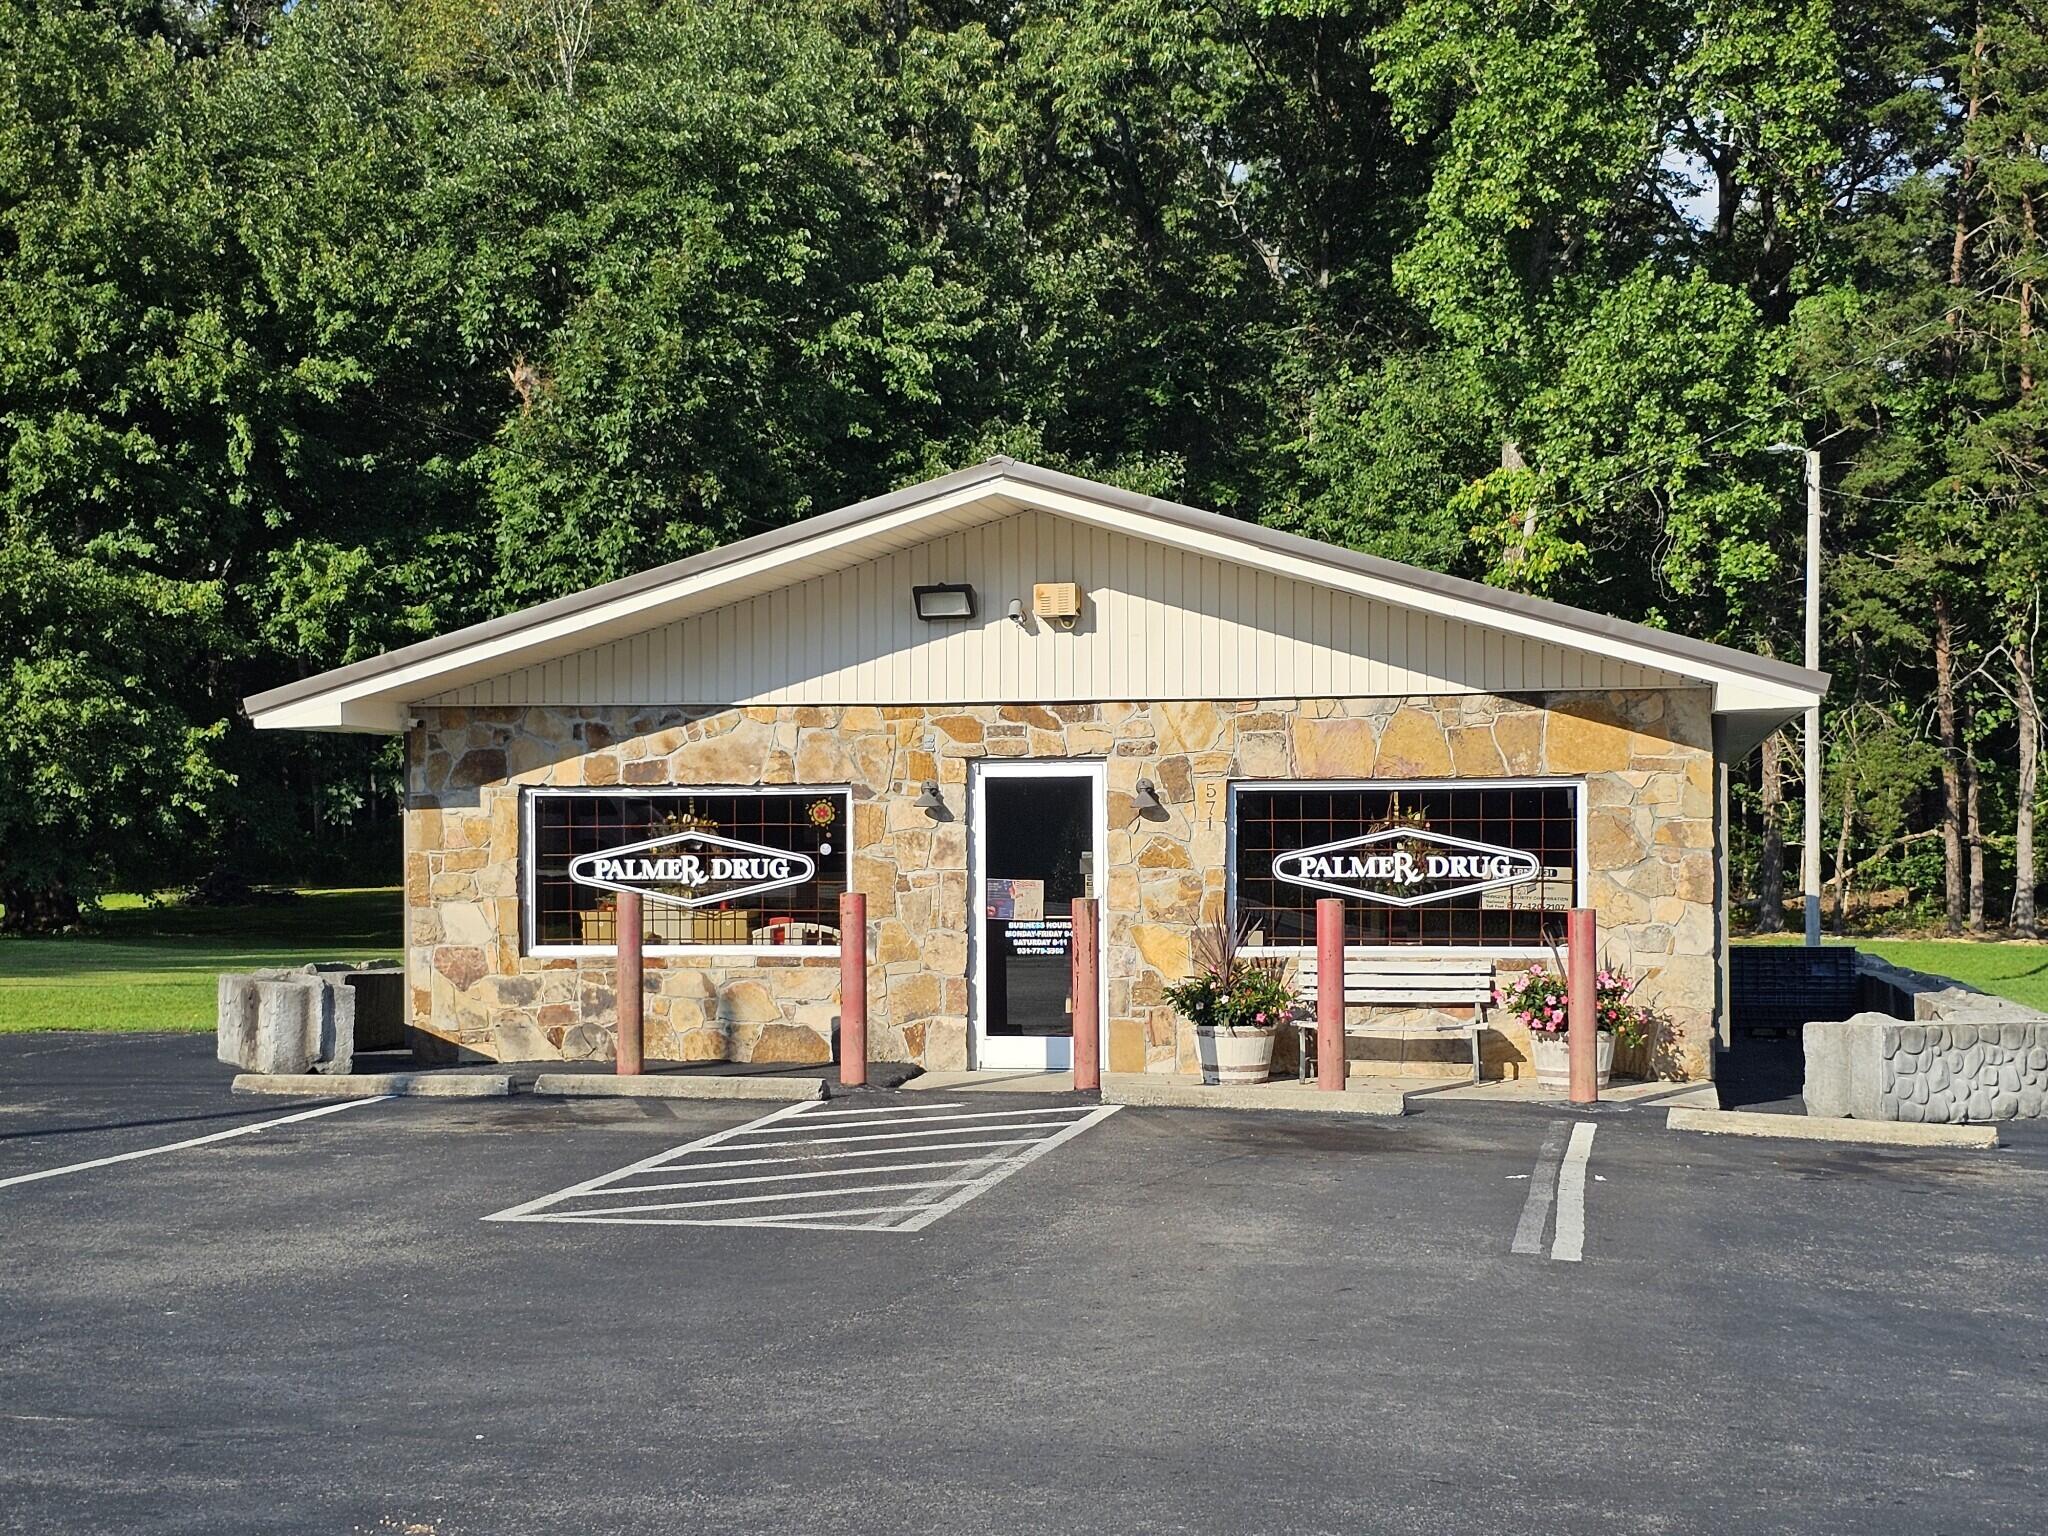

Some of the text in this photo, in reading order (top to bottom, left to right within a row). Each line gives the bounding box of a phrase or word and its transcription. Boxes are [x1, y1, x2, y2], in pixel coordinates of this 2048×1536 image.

[711, 858, 790, 879] DRUG
[1426, 856, 1513, 878] DRUG
[1008, 921, 1072, 929] BUSINESS HOURS
[1005, 930, 1064, 938] MONDAY-FRIDAY
[1013, 938, 1051, 946] SATURDAY
